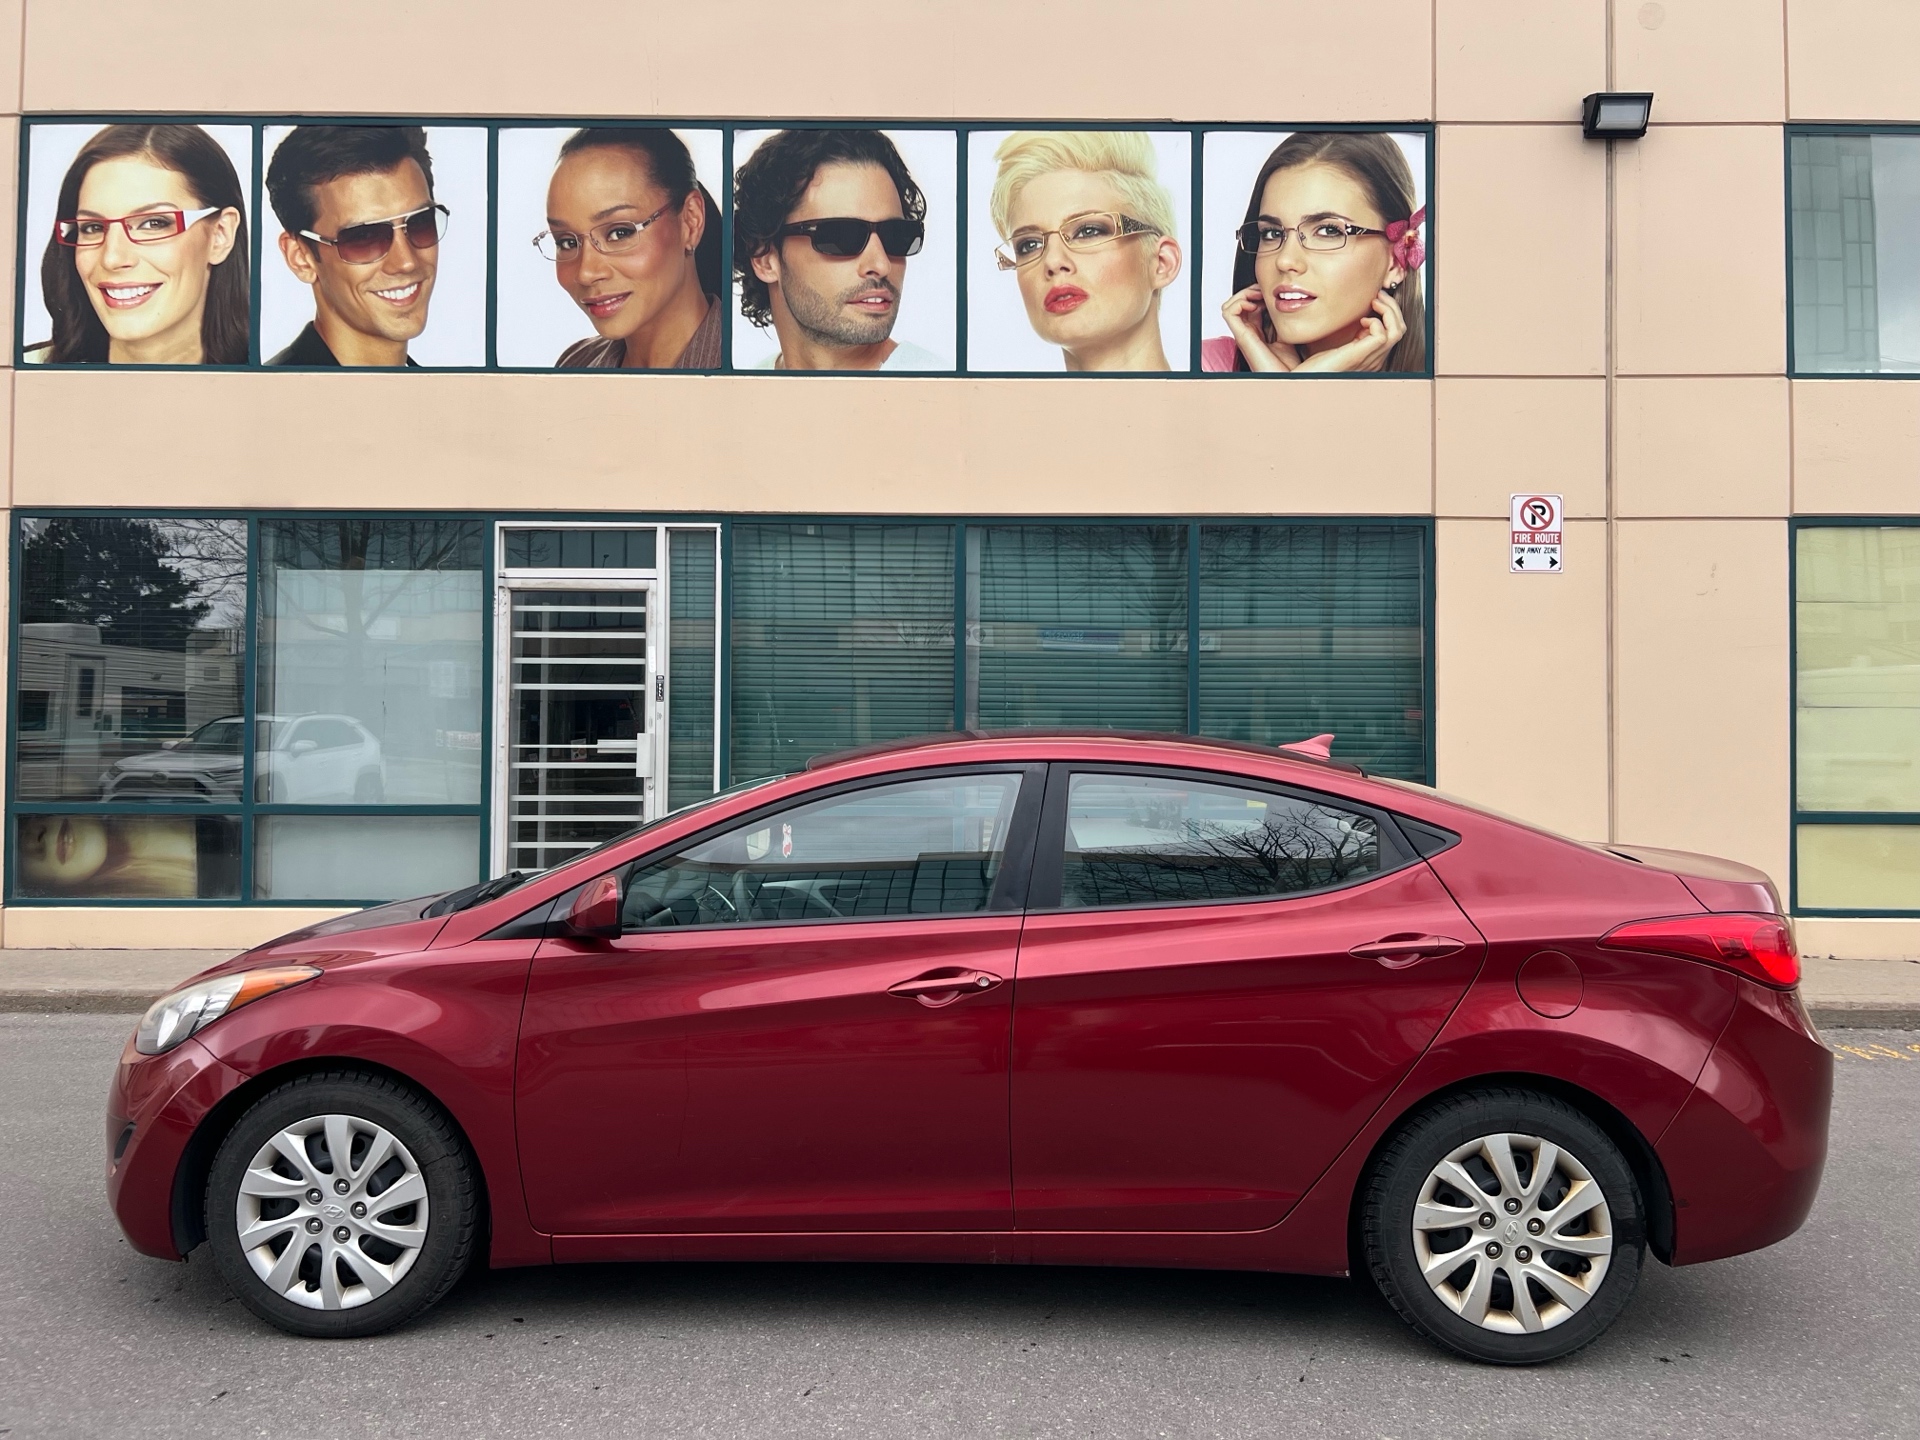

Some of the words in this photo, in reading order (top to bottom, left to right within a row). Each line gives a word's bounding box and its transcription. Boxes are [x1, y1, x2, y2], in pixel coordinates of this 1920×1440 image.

[1514, 532, 1532, 543] FIRE
[1534, 532, 1560, 544] ROUTE
[1514, 546, 1526, 554] TOW
[1526, 546, 1542, 554] AWAY
[1543, 546, 1558, 554] ZONE
